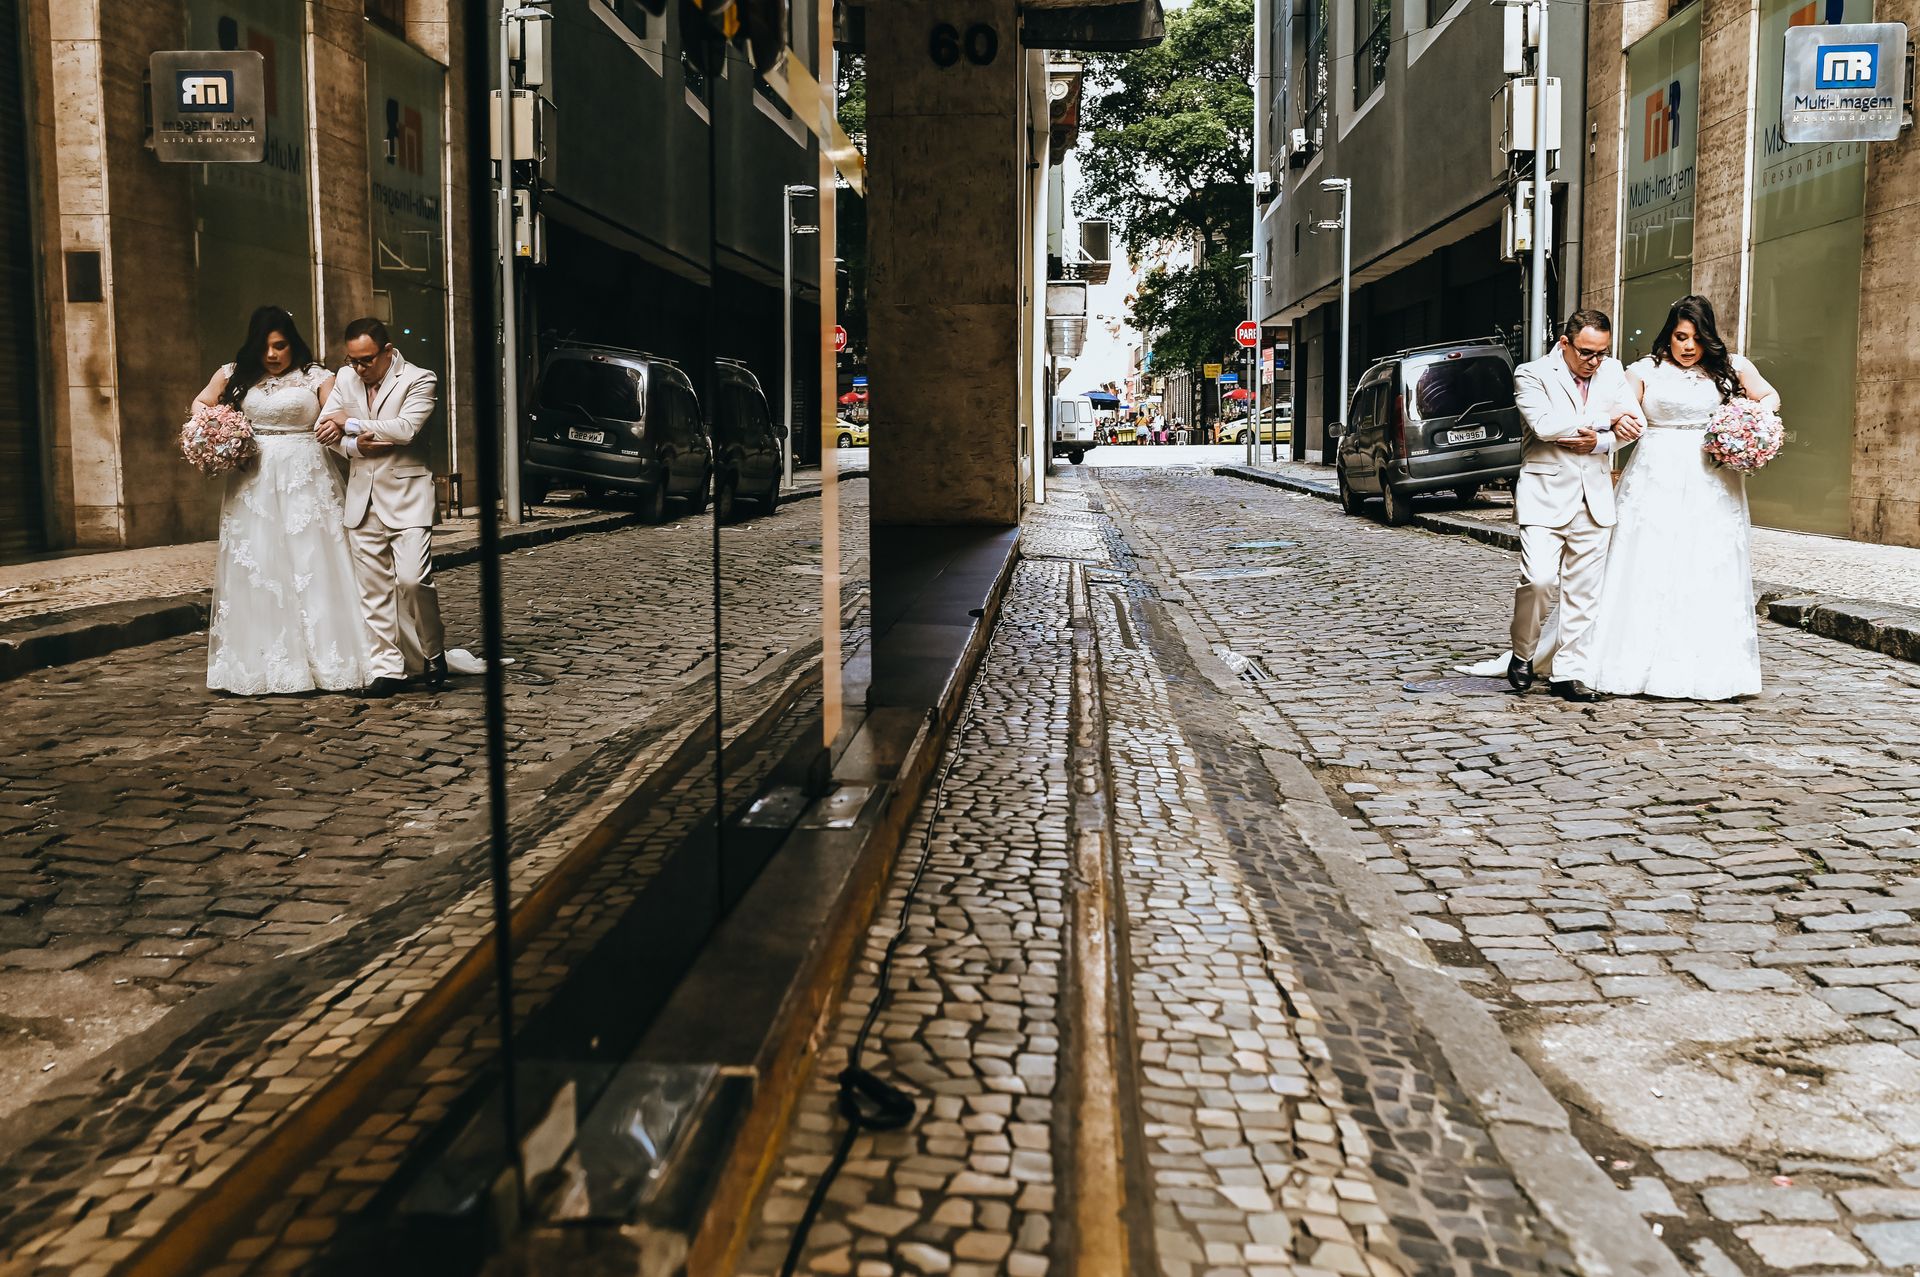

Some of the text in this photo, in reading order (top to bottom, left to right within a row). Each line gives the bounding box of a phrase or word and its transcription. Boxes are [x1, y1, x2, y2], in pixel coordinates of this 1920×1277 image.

[929, 23, 998, 67] 60
[1792, 112, 1893, 123] Ressonância
[1794, 94, 1893, 112] Multi-Imagem
[1630, 166, 1693, 210] Multi-Imagem
